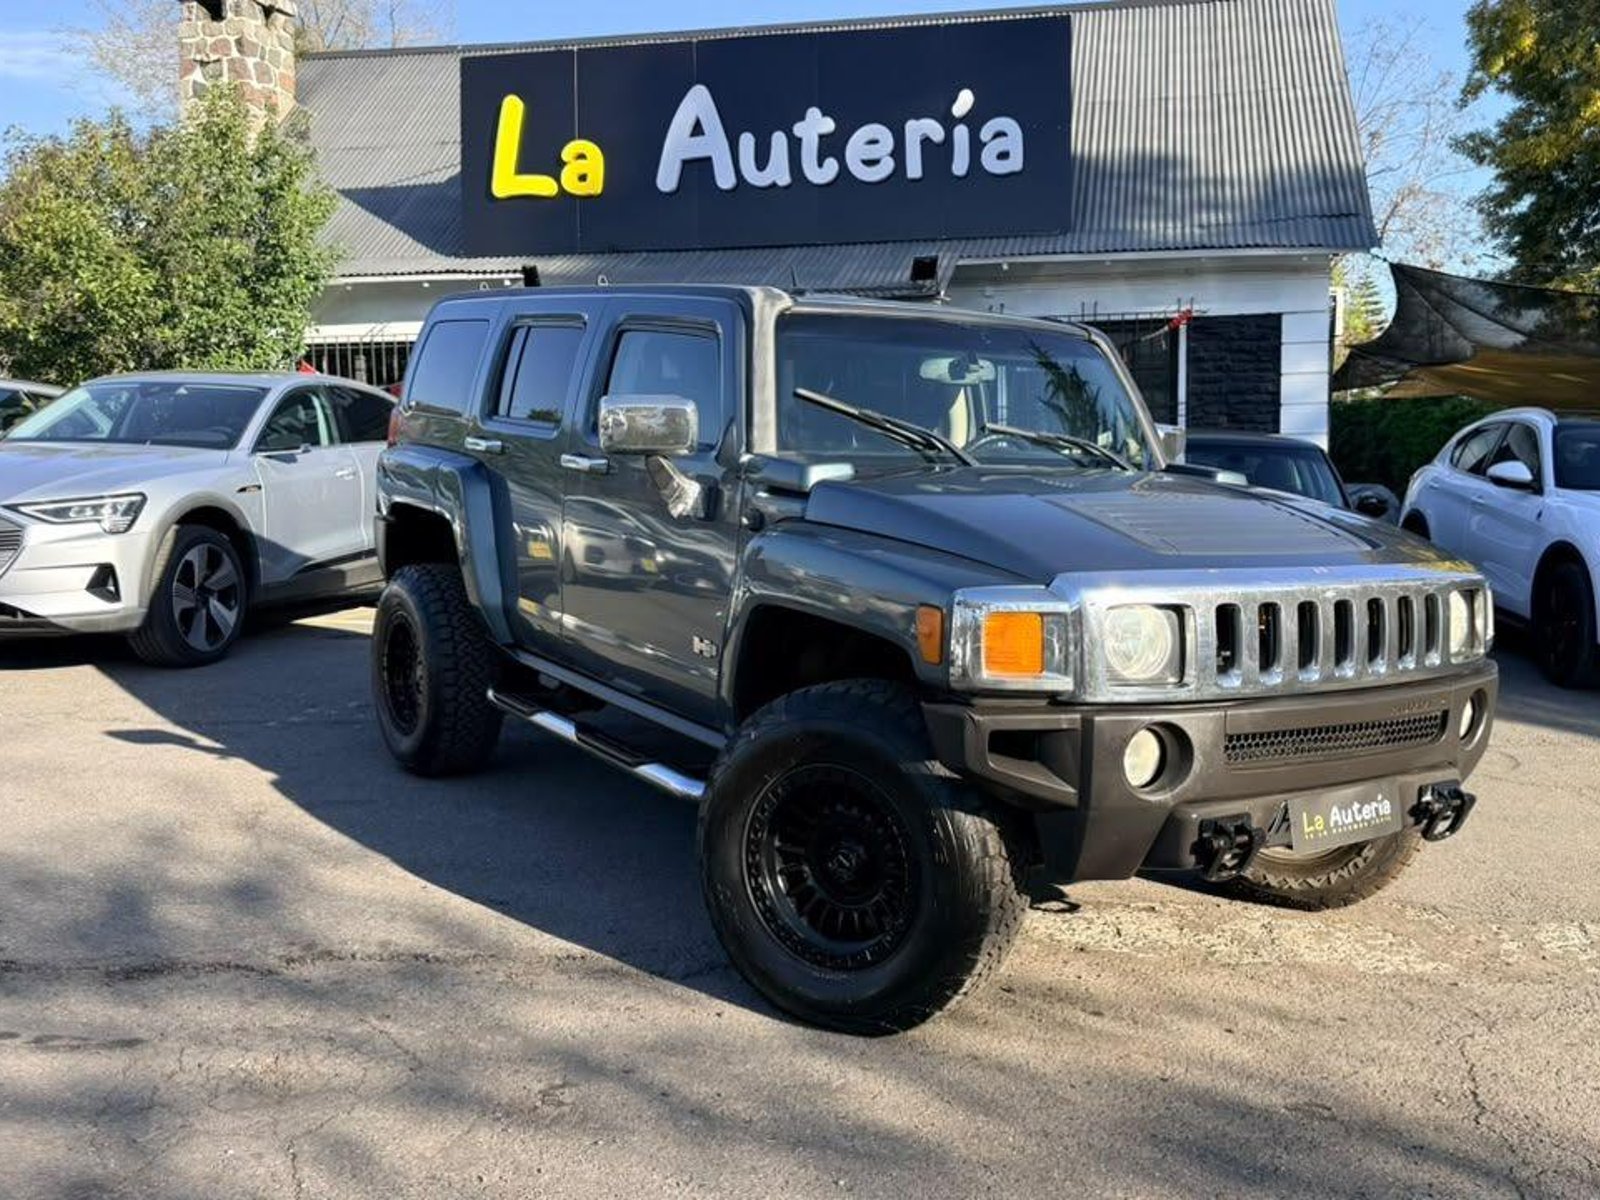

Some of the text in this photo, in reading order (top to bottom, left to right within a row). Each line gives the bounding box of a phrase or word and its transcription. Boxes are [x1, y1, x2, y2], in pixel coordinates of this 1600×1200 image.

[491, 84, 1023, 198] La Autería
[1303, 812, 1324, 833] La
[1330, 794, 1391, 827] Autería
